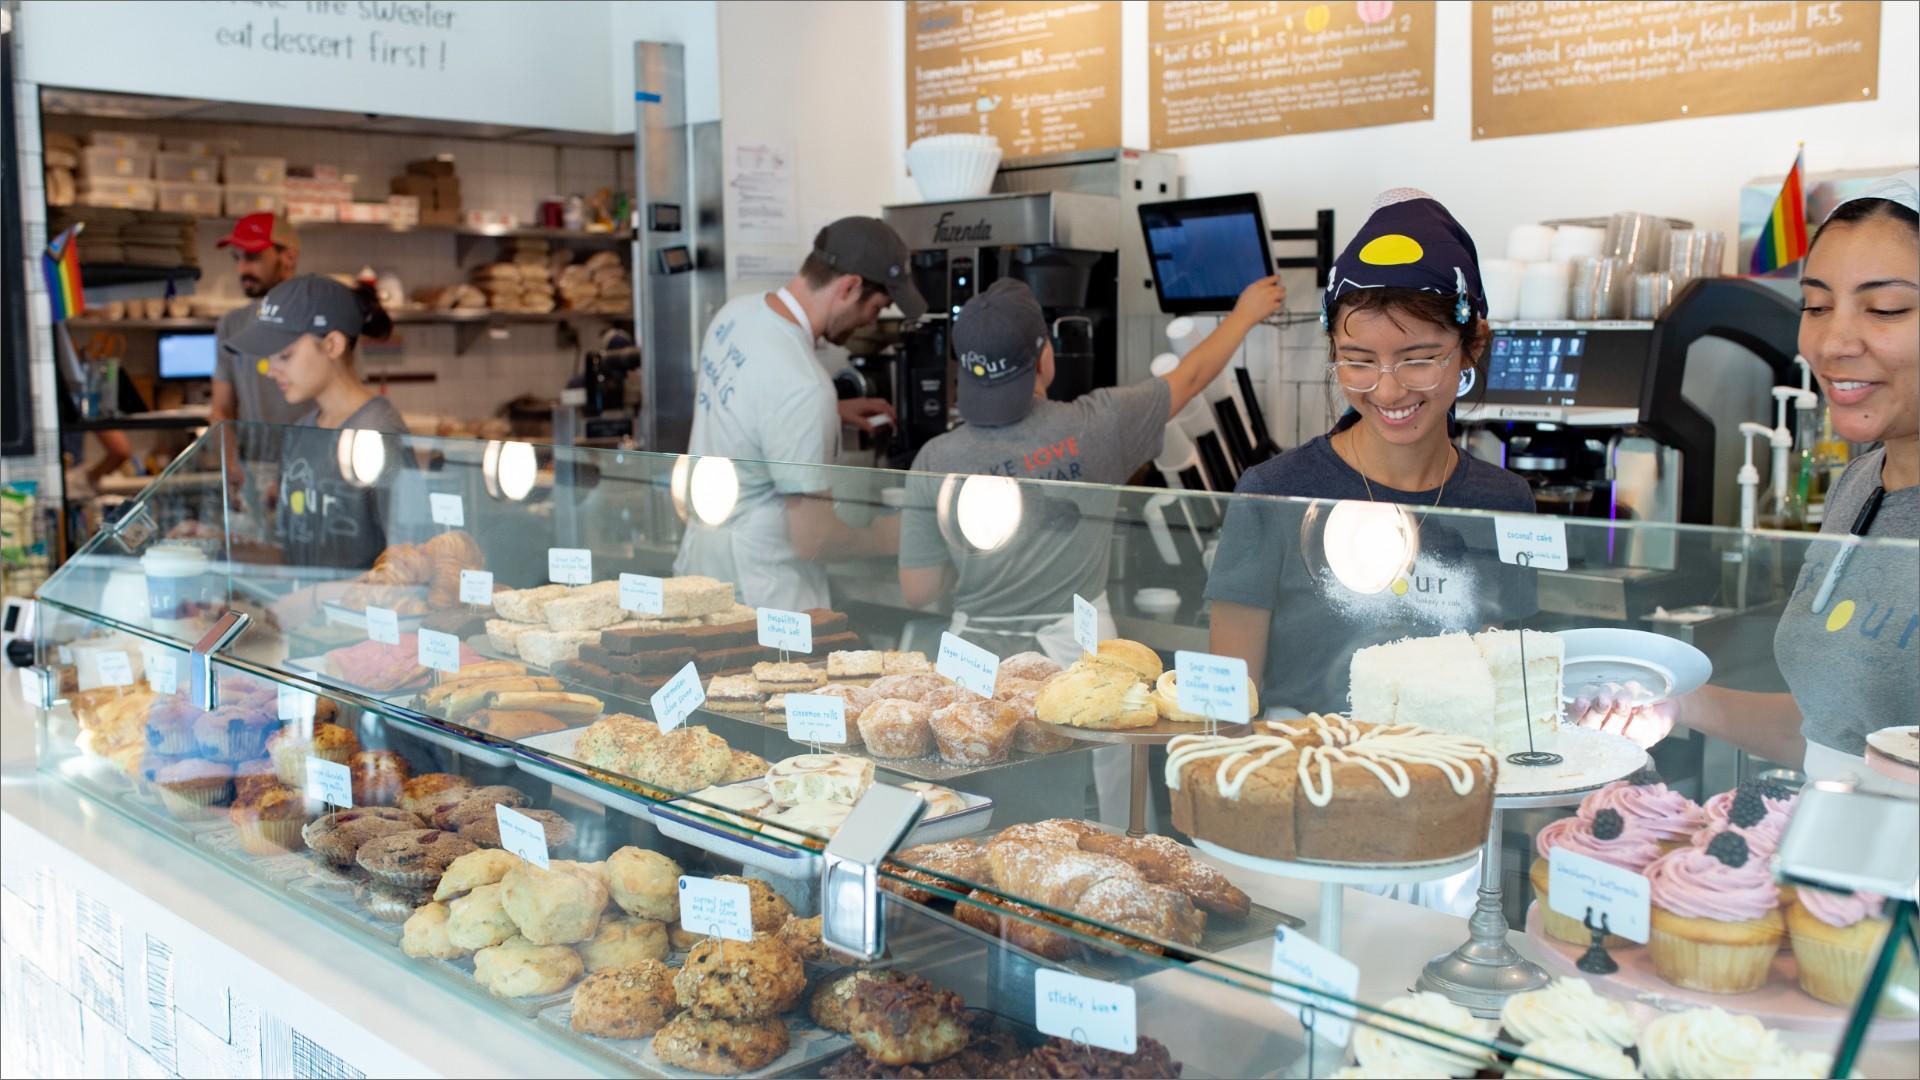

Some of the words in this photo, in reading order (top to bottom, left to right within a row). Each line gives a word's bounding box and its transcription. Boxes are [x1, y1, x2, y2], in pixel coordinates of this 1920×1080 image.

[358, 0, 458, 28] sweeter
[1566, 35, 1632, 58] salmon
[1648, 25, 1696, 52] baby
[1748, 2, 1797, 37] bowl
[215, 22, 253, 49] eat
[261, 16, 354, 59] dessert
[369, 29, 428, 69] first
[933, 211, 993, 244] Fazenda
[1023, 435, 1081, 472] LOVE
[1506, 530, 1533, 542] coconut
[1537, 533, 1553, 543] cake
[1048, 988, 1084, 1011] sticky
